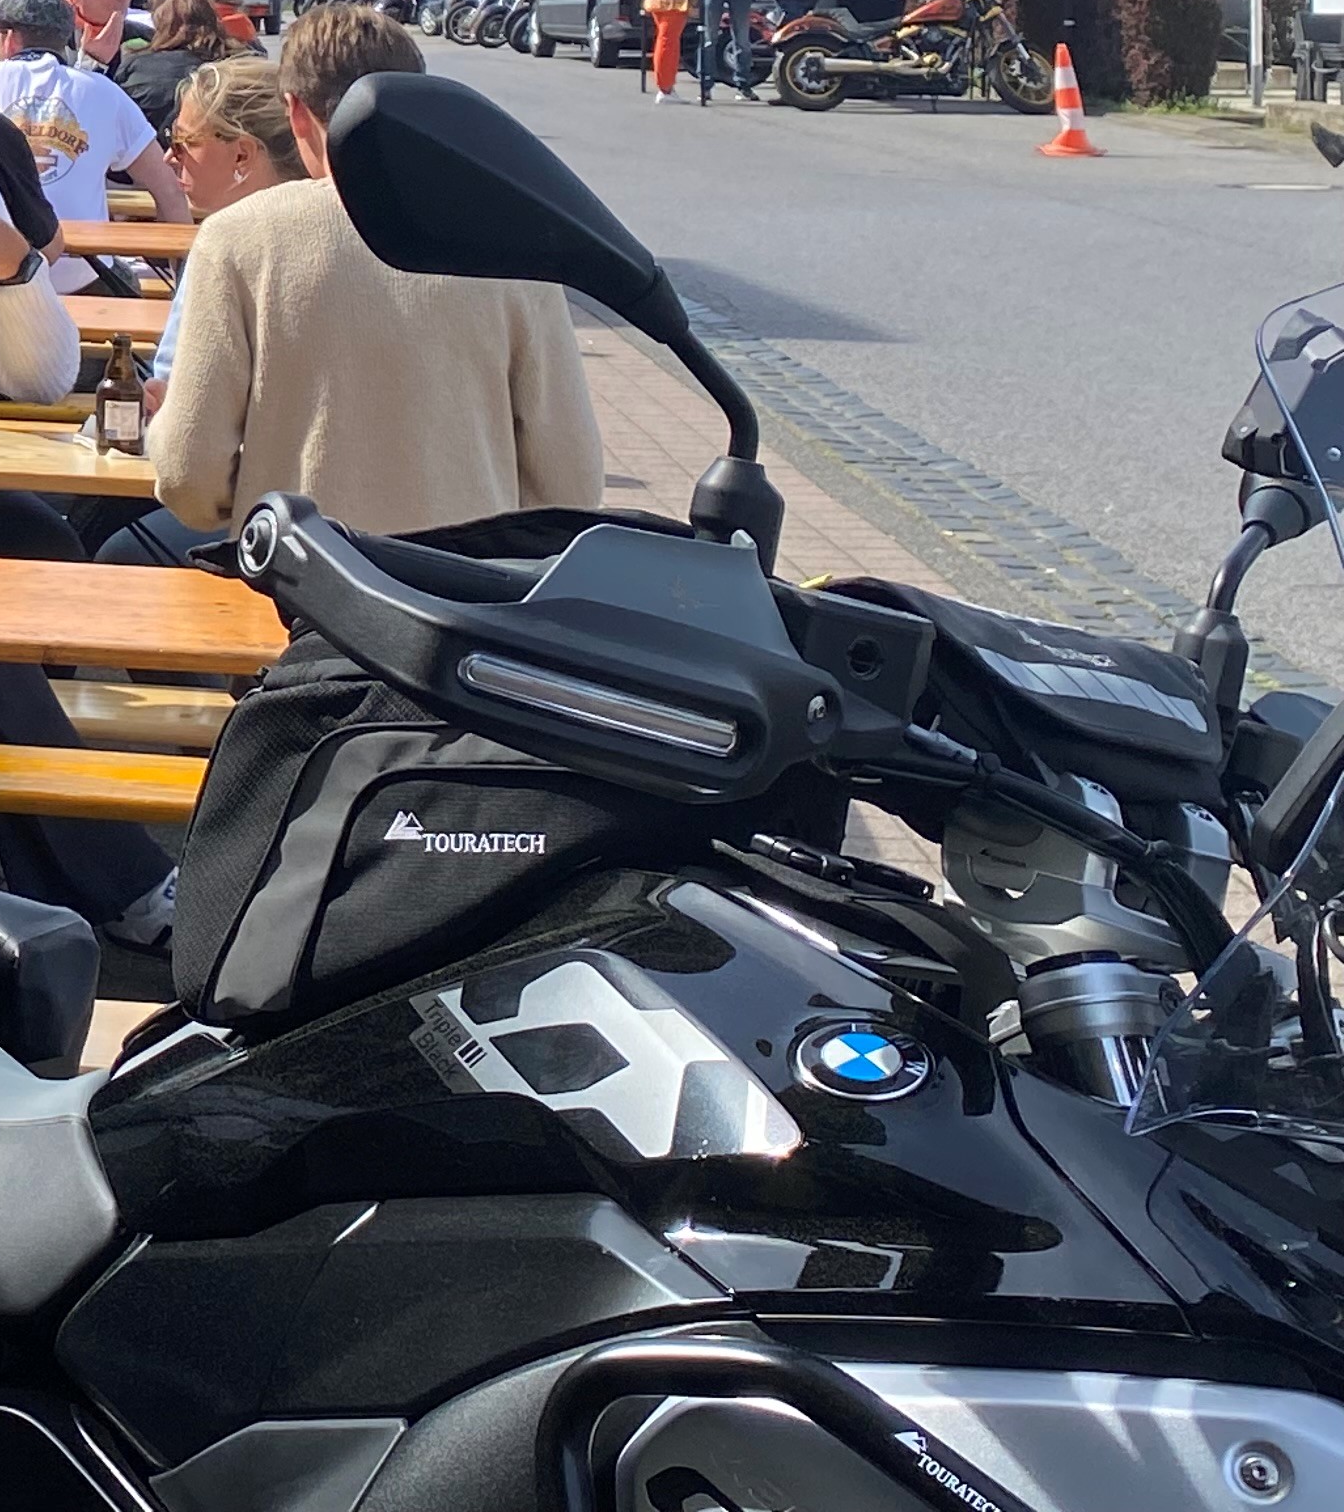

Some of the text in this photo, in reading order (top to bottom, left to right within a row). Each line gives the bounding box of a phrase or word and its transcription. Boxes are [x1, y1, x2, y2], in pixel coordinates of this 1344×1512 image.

[422, 832, 546, 854] TOURATECH
[424, 998, 461, 1046] Triple
[415, 1031, 461, 1080] Black
